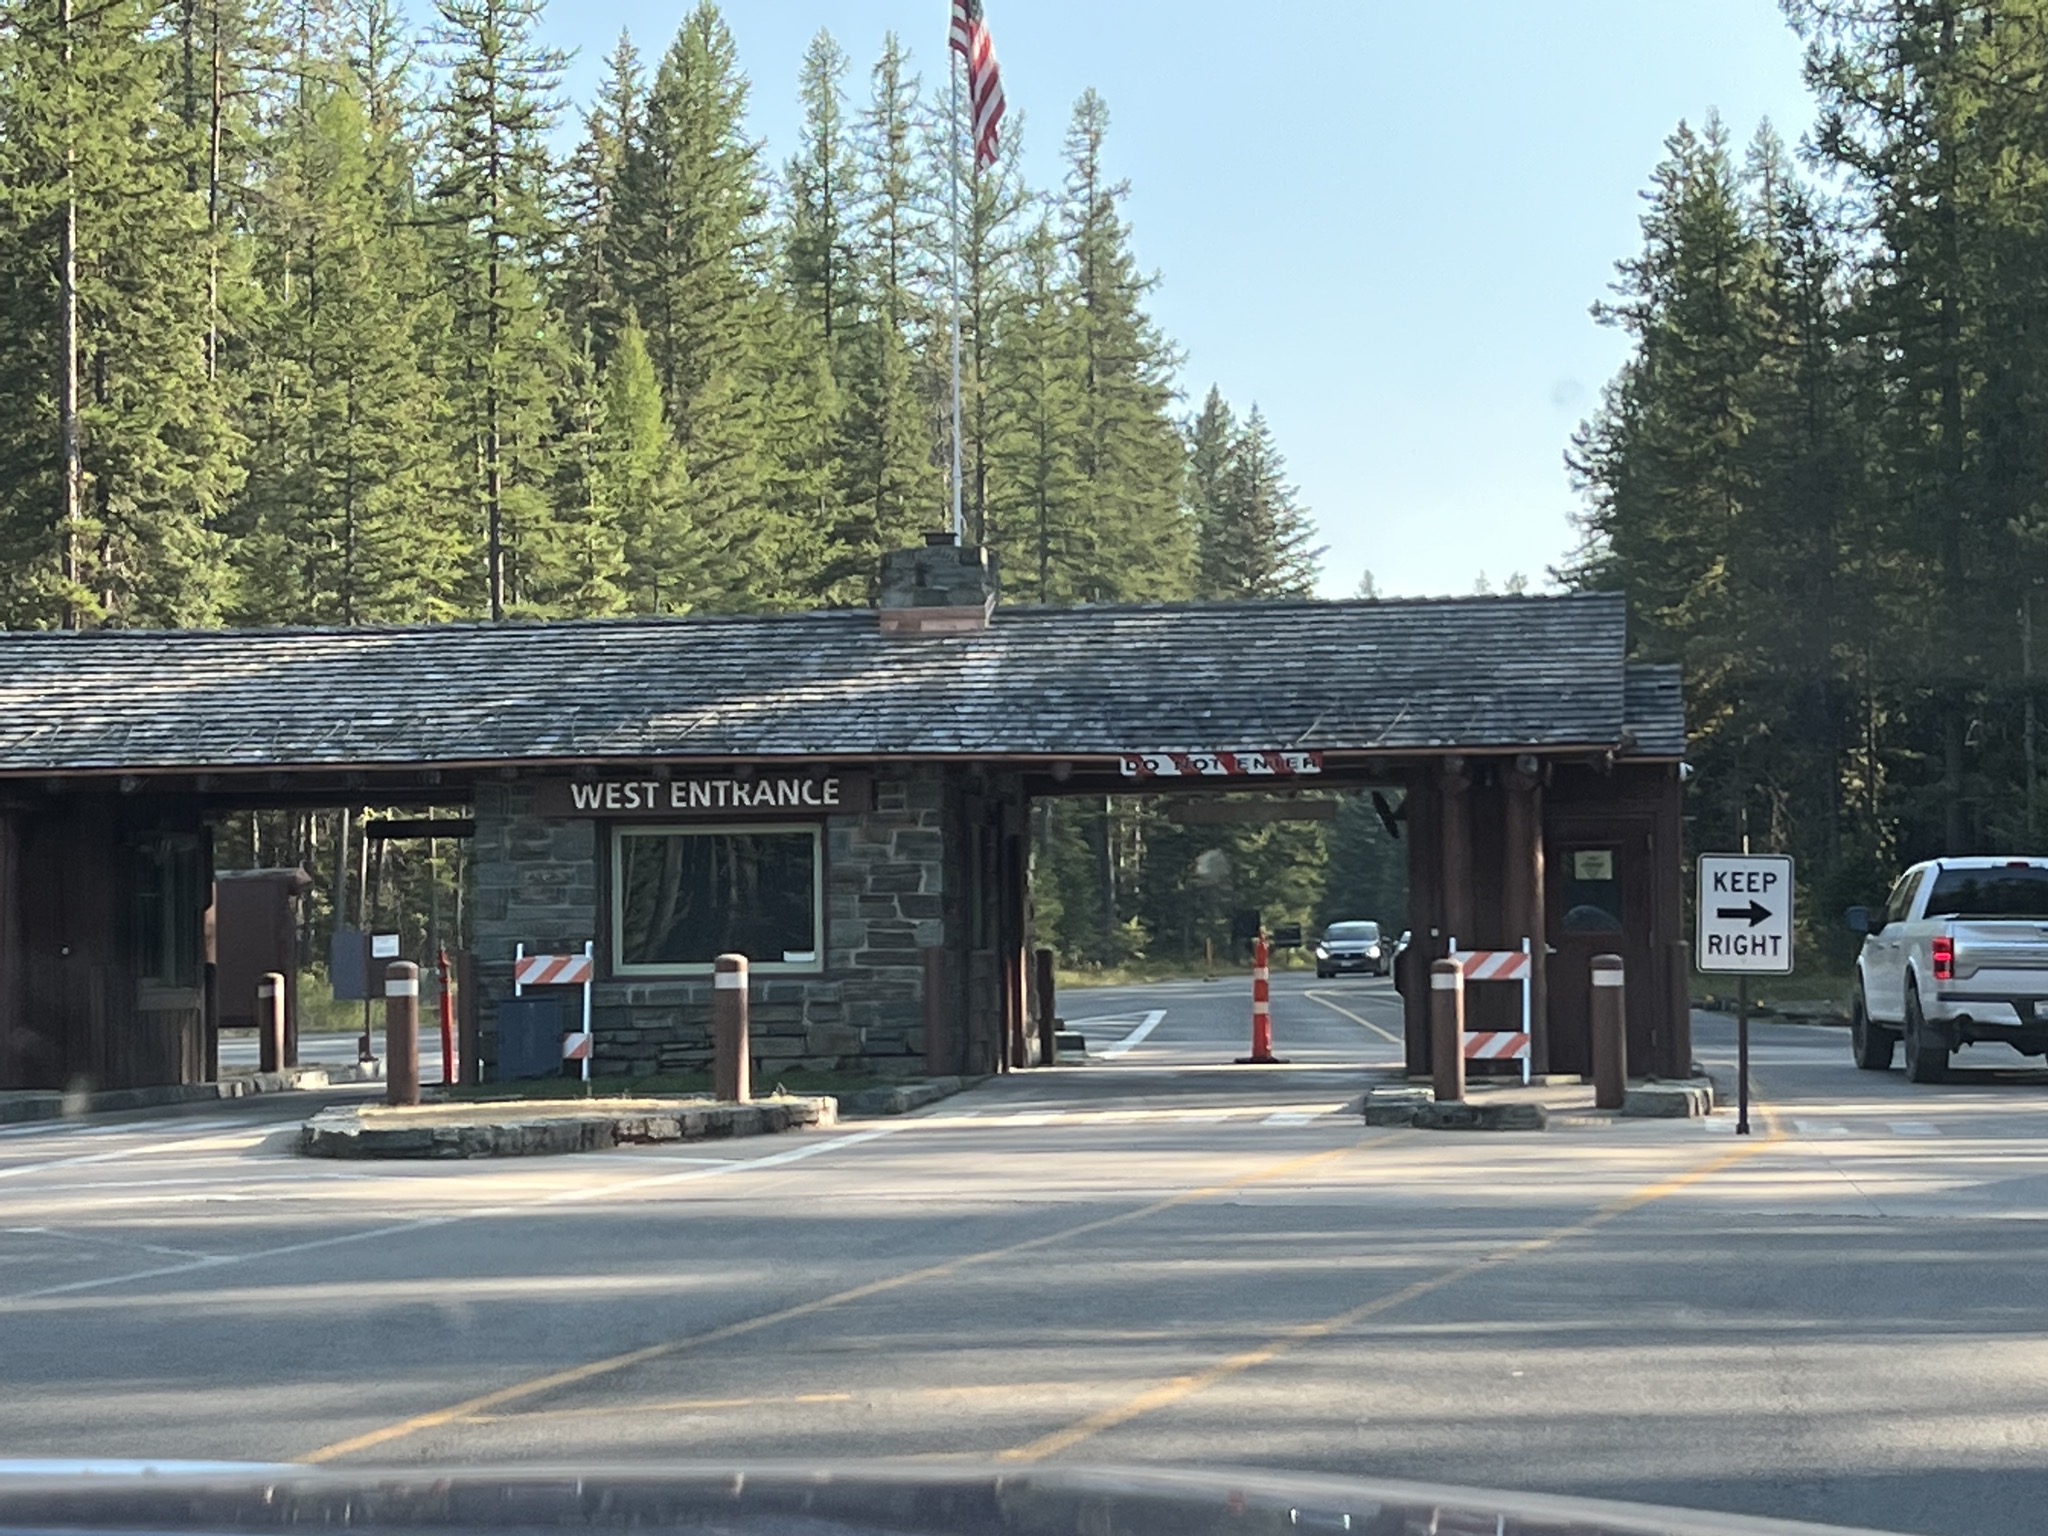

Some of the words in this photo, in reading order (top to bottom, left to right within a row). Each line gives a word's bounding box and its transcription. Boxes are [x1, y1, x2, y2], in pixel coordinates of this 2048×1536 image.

[1126, 761, 1159, 771] DO
[1174, 759, 1219, 771] NOT
[1237, 757, 1316, 770] ENTER
[571, 783, 659, 808] WEST
[671, 779, 840, 807] ENTRANCE
[1714, 871, 1777, 893] KEEP
[1708, 934, 1782, 956] RIGHT
